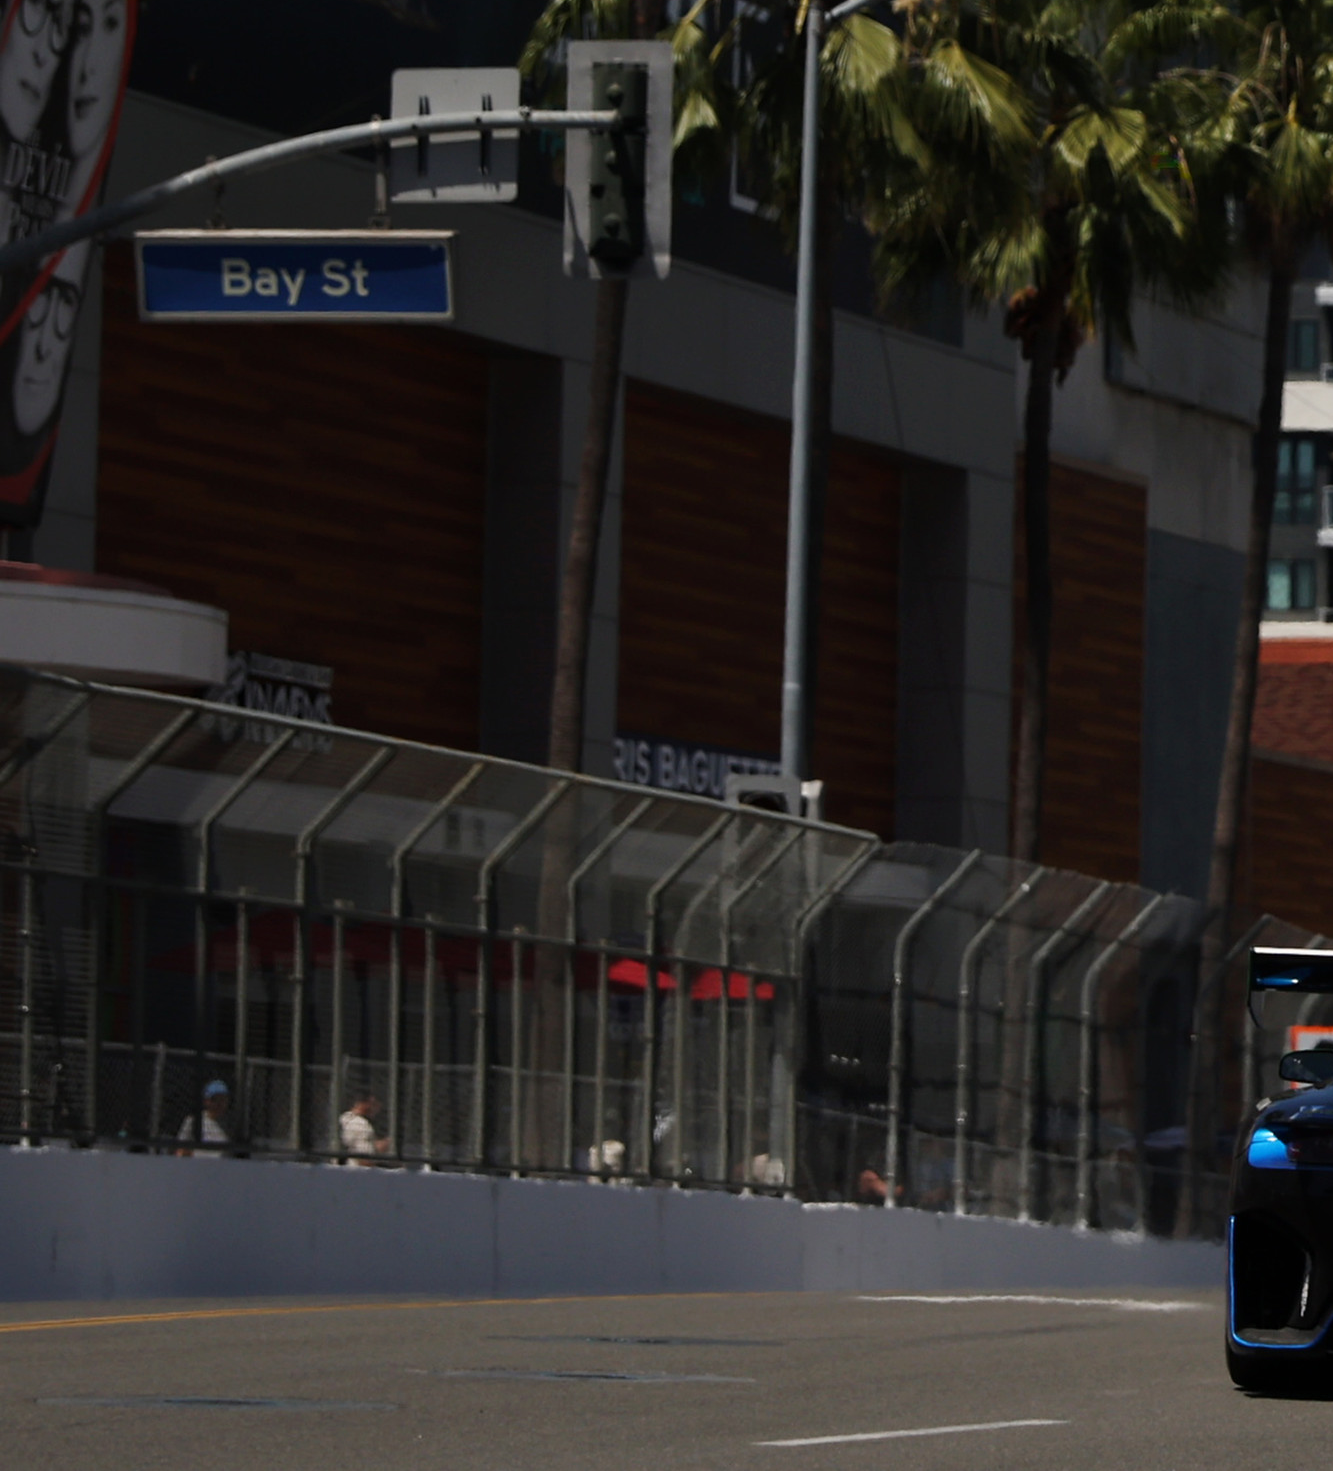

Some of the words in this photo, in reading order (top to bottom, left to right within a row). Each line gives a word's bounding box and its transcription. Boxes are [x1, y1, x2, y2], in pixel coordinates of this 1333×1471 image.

[221, 257, 306, 306] Bay
[322, 258, 370, 297] St
[657, 743, 782, 795] BAGU
